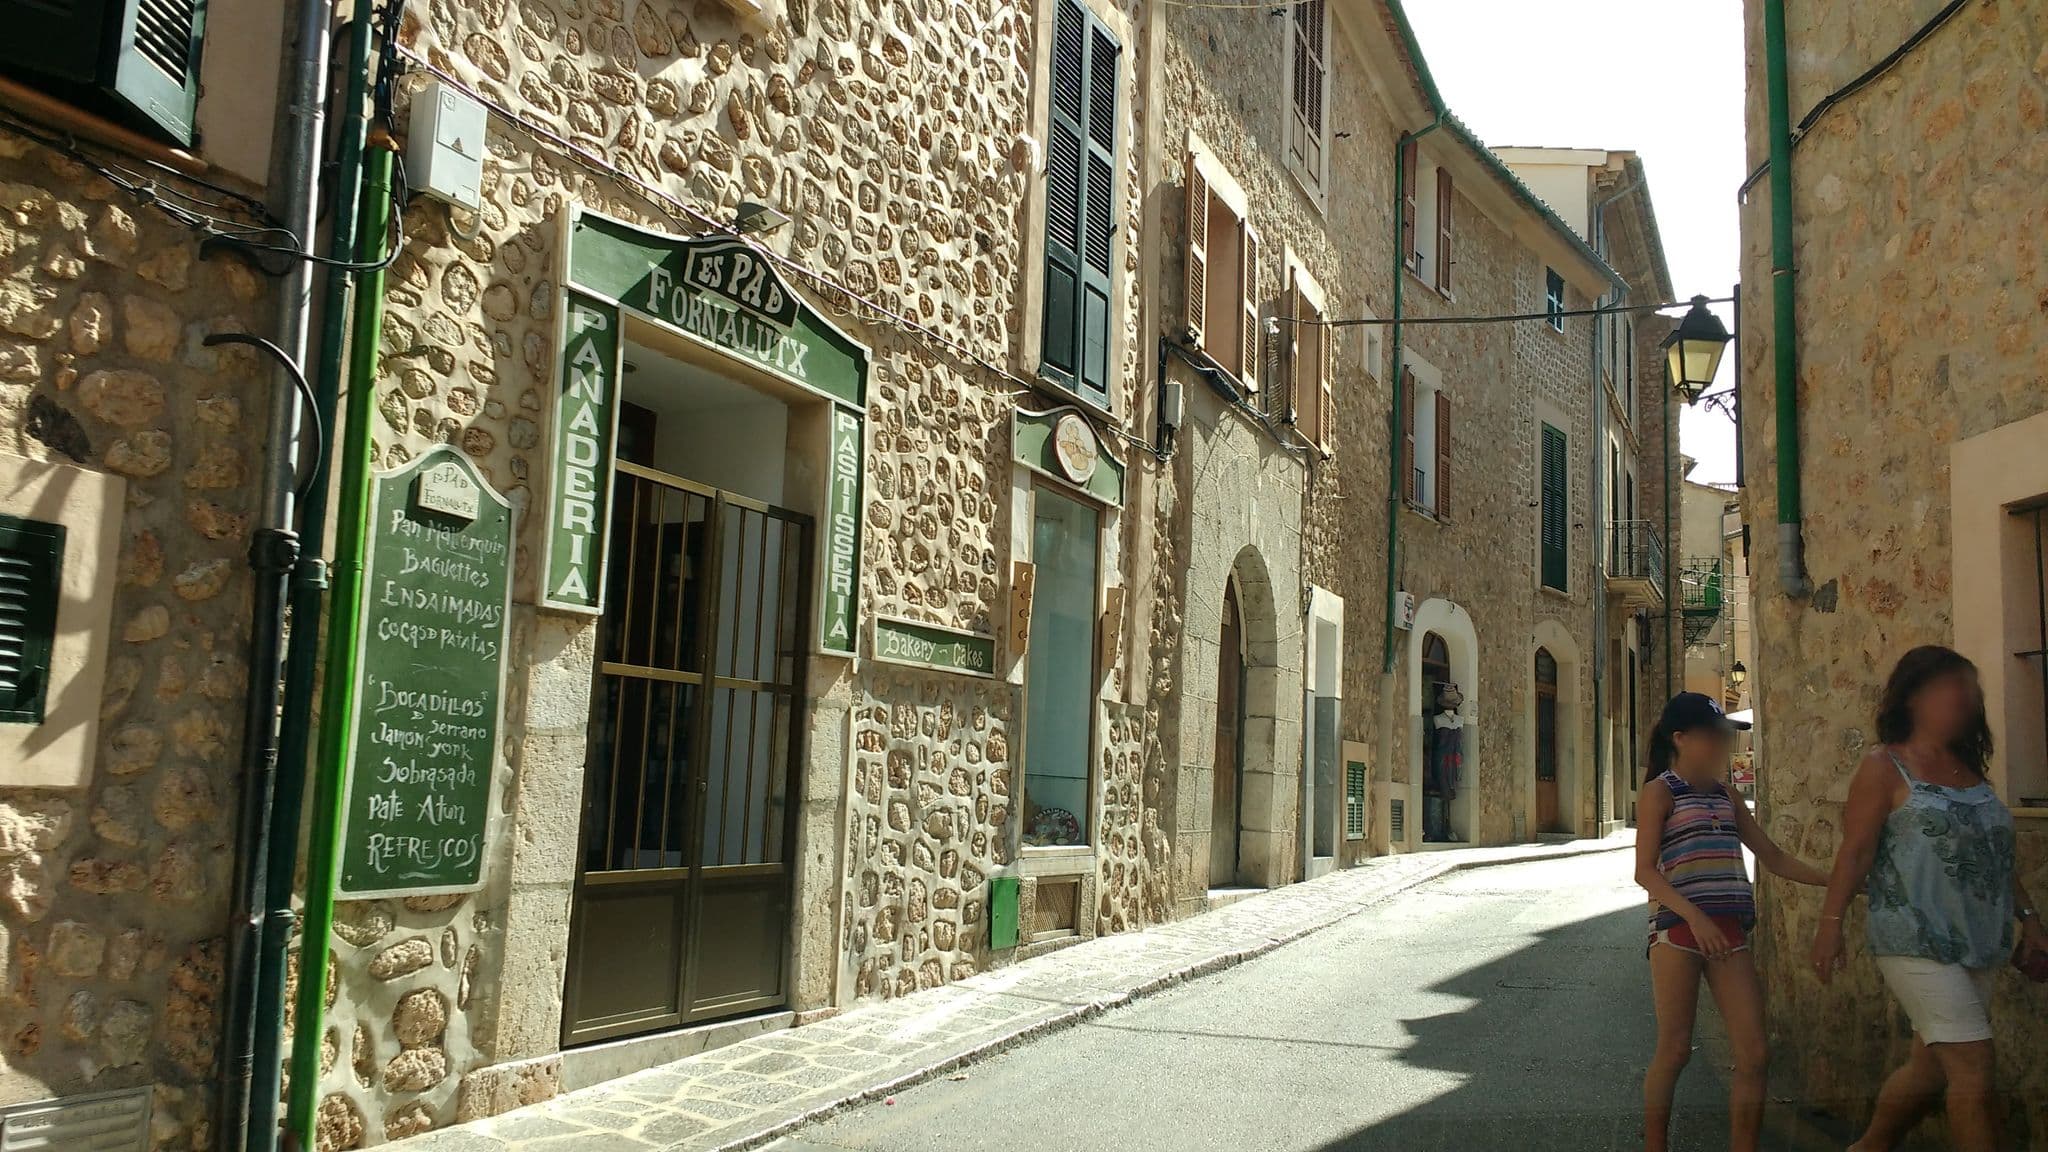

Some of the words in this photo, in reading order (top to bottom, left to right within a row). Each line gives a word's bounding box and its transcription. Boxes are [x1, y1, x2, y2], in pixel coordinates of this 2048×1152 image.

[698, 255, 724, 288] ES
[646, 261, 809, 377] FORNALUTX
[557, 303, 608, 600] PANADERIA
[390, 509, 421, 537] Pan
[829, 411, 858, 640] PASTISSERIA
[884, 629, 936, 661] Bakery
[953, 643, 983, 668] Cakes
[429, 719, 487, 740] Serrano
[377, 756, 476, 791] Sobrasada
[417, 794, 466, 826] Atun
[367, 833, 479, 873] REFRESCOS
